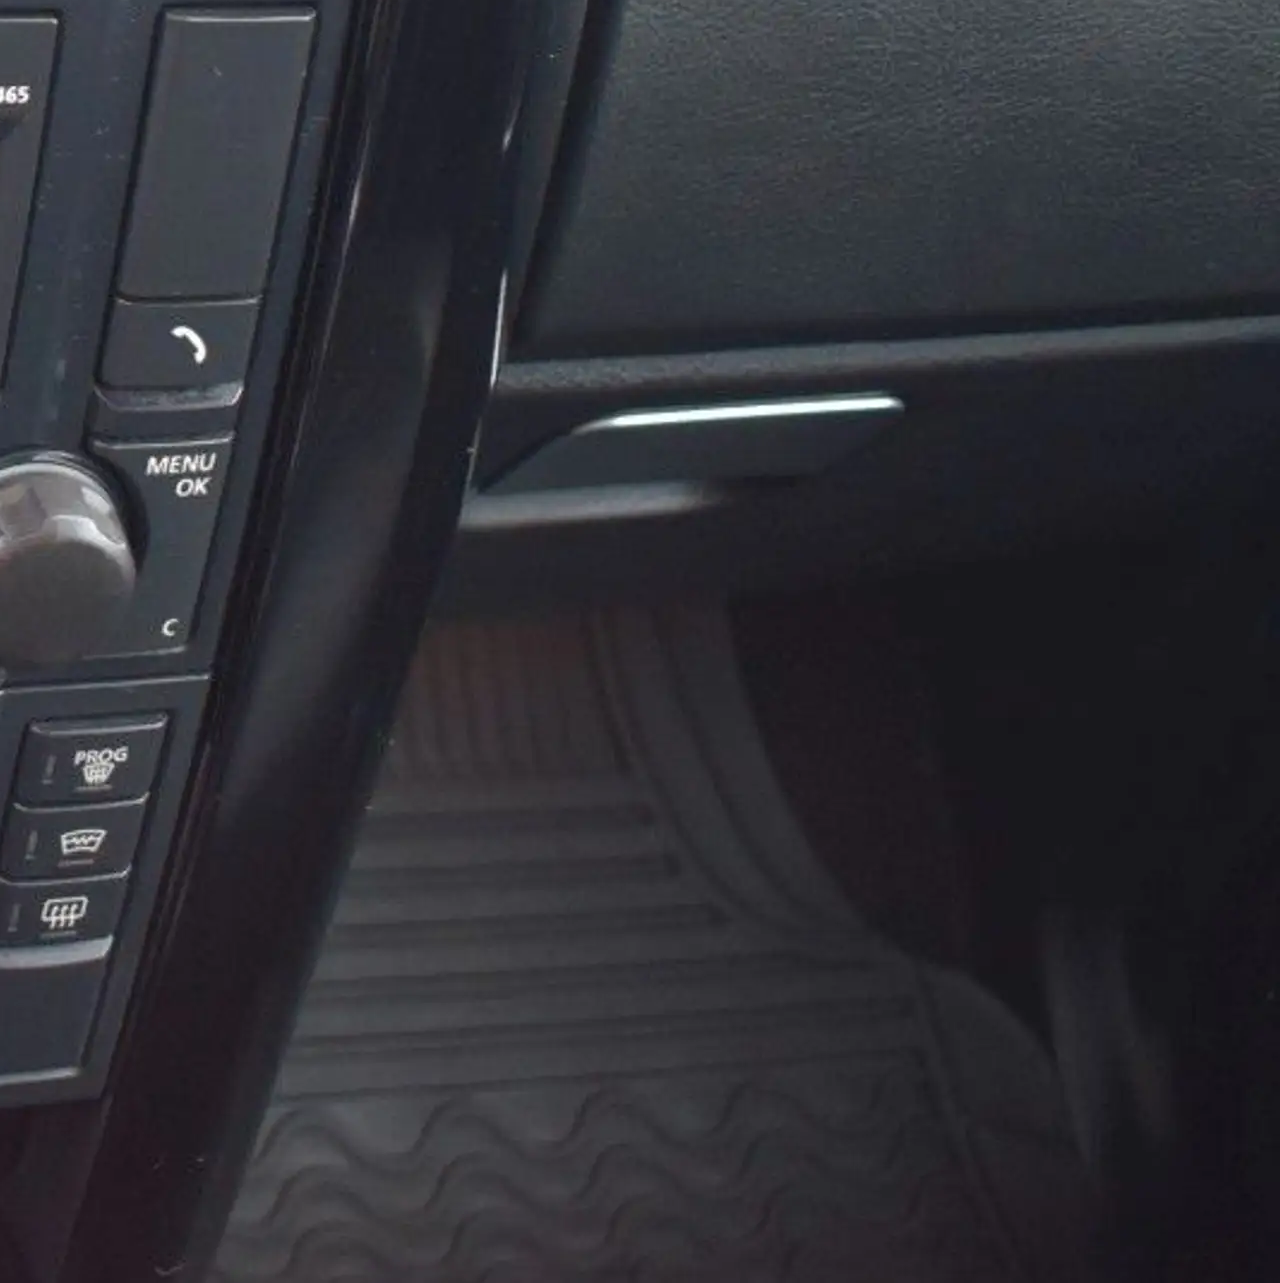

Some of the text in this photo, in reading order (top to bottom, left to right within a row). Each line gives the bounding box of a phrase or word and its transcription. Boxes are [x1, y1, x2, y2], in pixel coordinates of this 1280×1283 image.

[145, 453, 216, 476] MENU
[175, 477, 210, 497] OK
[161, 618, 179, 637] C
[74, 747, 128, 765] PROG
